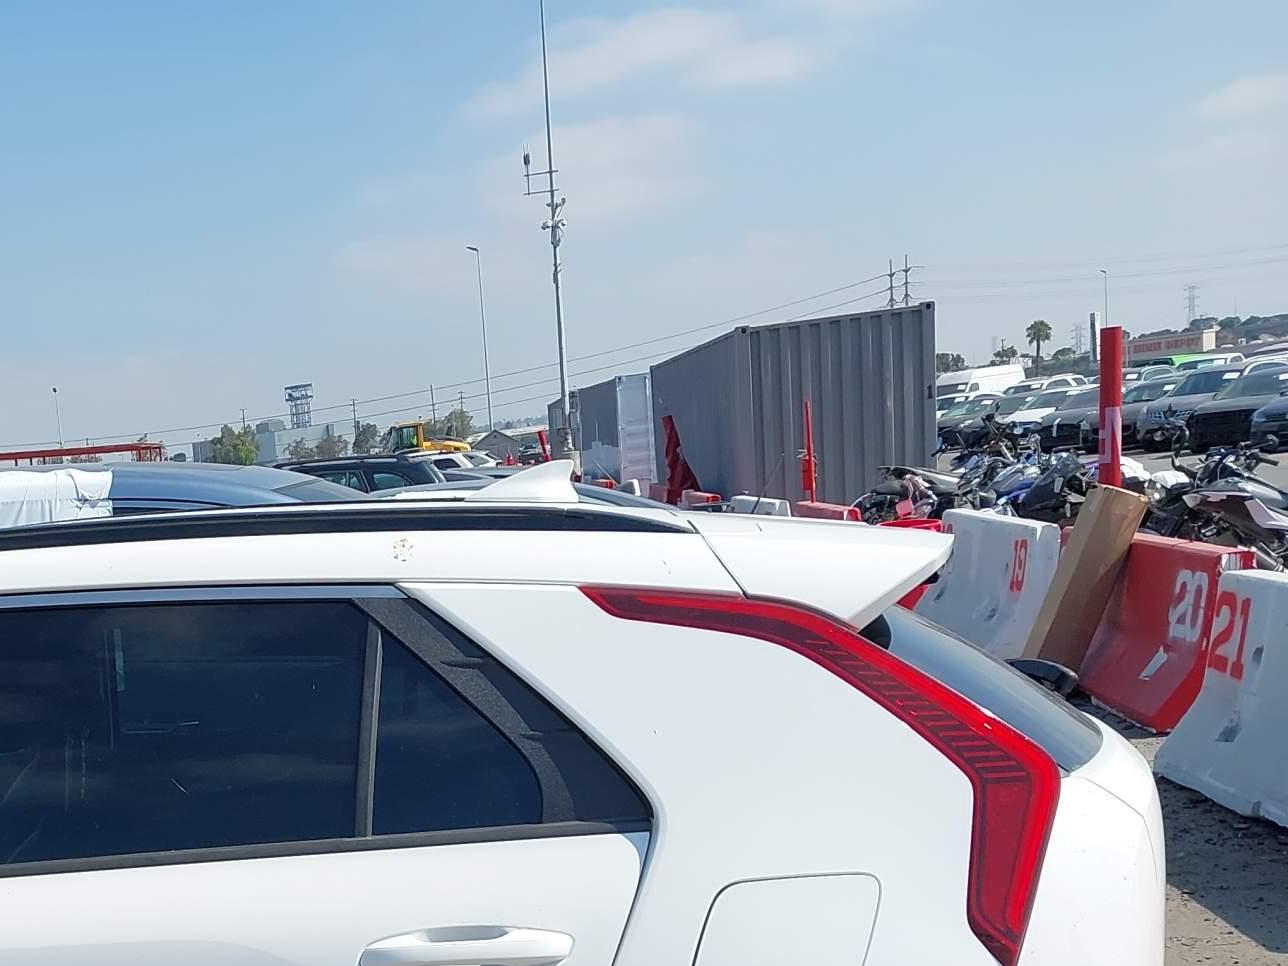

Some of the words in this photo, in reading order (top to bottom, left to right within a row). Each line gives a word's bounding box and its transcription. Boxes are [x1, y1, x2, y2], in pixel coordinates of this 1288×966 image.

[1010, 539, 1028, 593] 19
[1168, 569, 1209, 643] 20
[1208, 590, 1252, 680] 21
